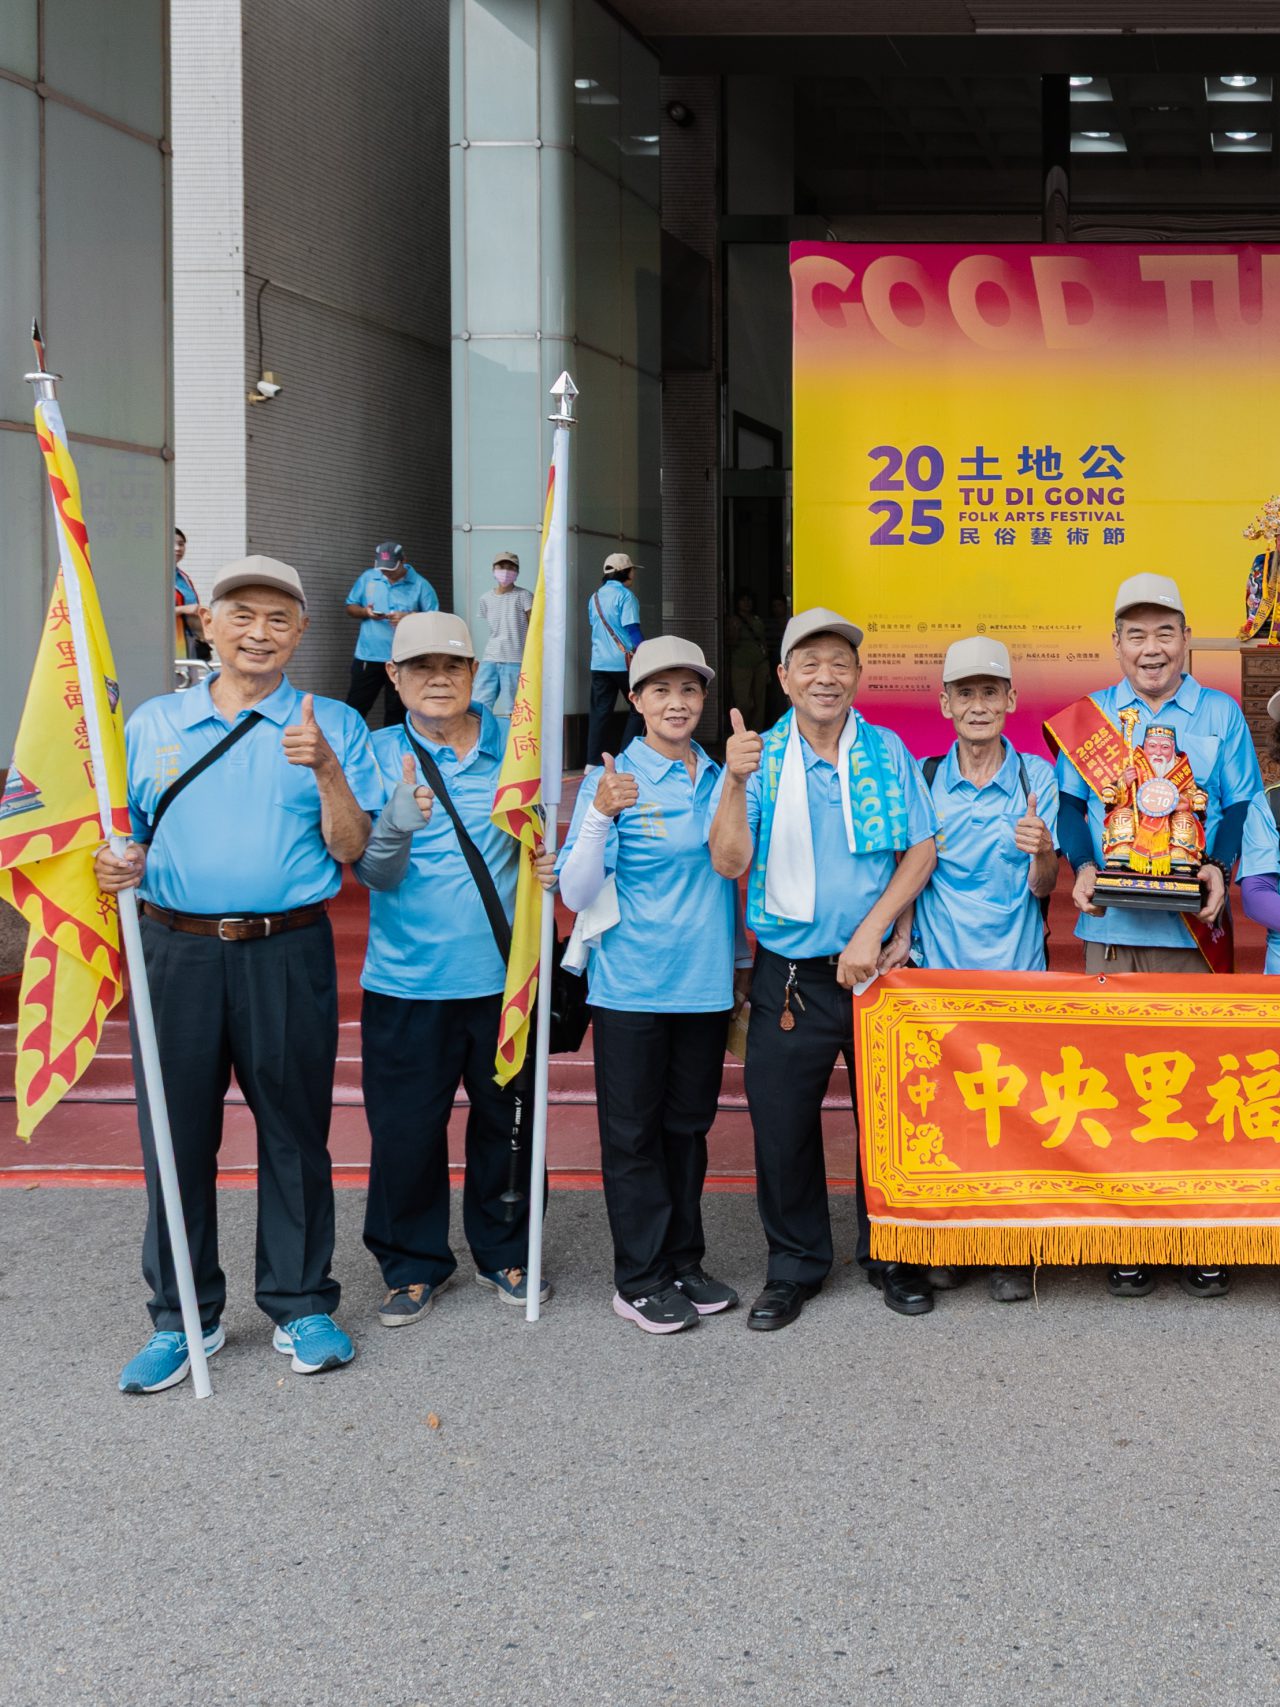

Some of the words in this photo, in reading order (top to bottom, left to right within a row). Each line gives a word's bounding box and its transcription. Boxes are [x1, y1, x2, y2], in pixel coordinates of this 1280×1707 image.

[790, 254, 1098, 351] GOOD
[867, 445, 944, 492] 20
[957, 445, 1126, 481] 土地公
[959, 487, 994, 506] TU
[1005, 487, 1033, 506] DI
[1044, 487, 1126, 506] GONG
[867, 499, 944, 546] 25
[959, 511, 999, 522] FOLK
[1004, 511, 1045, 522] ARTS
[1050, 511, 1125, 522] FESTIVAL
[959, 527, 1126, 546] 民俗藝術節
[1075, 727, 1110, 758] 2025
[907, 1074, 938, 1118] 中
